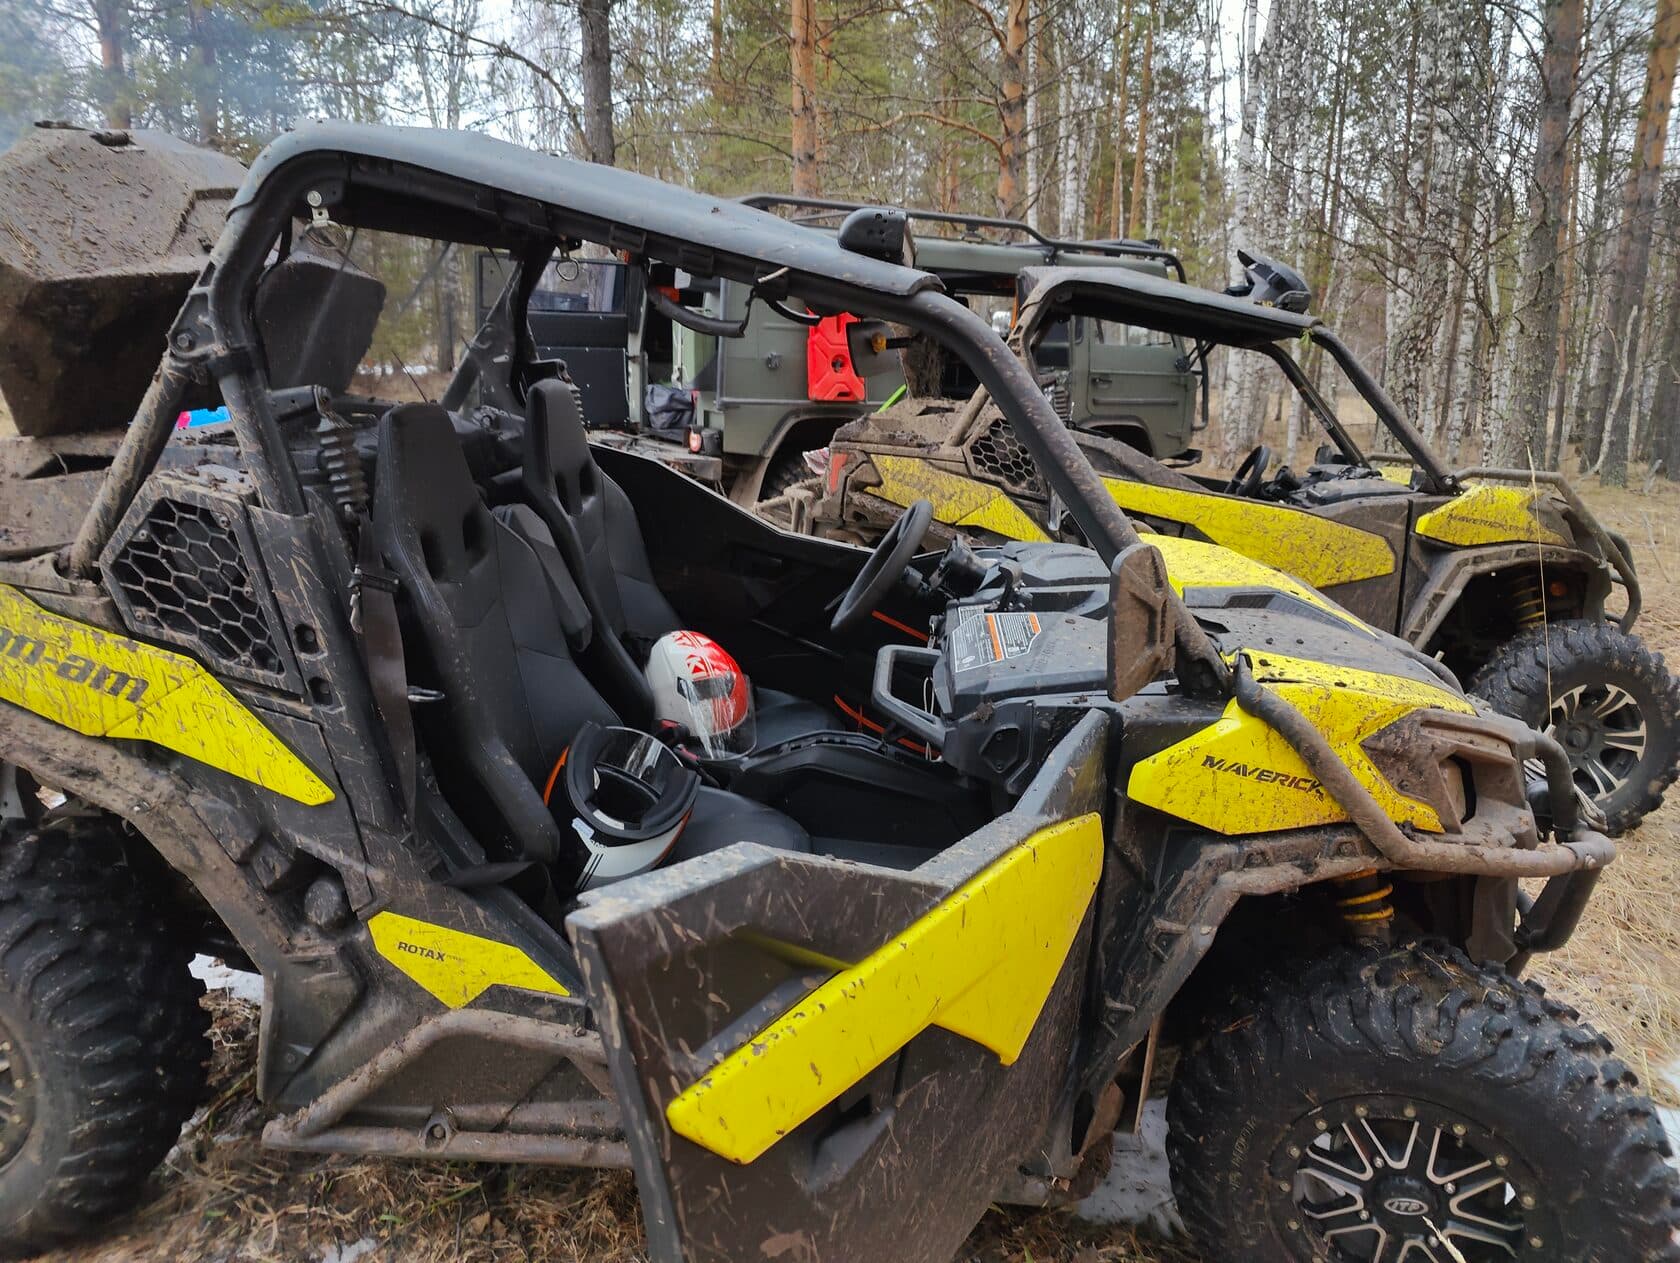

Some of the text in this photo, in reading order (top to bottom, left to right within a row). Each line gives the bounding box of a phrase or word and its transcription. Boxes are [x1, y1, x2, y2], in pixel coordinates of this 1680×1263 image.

[1201, 754, 1324, 800] MAVERICK
[397, 941, 446, 962] ROTAX
[1391, 1201, 1420, 1212] ITP
